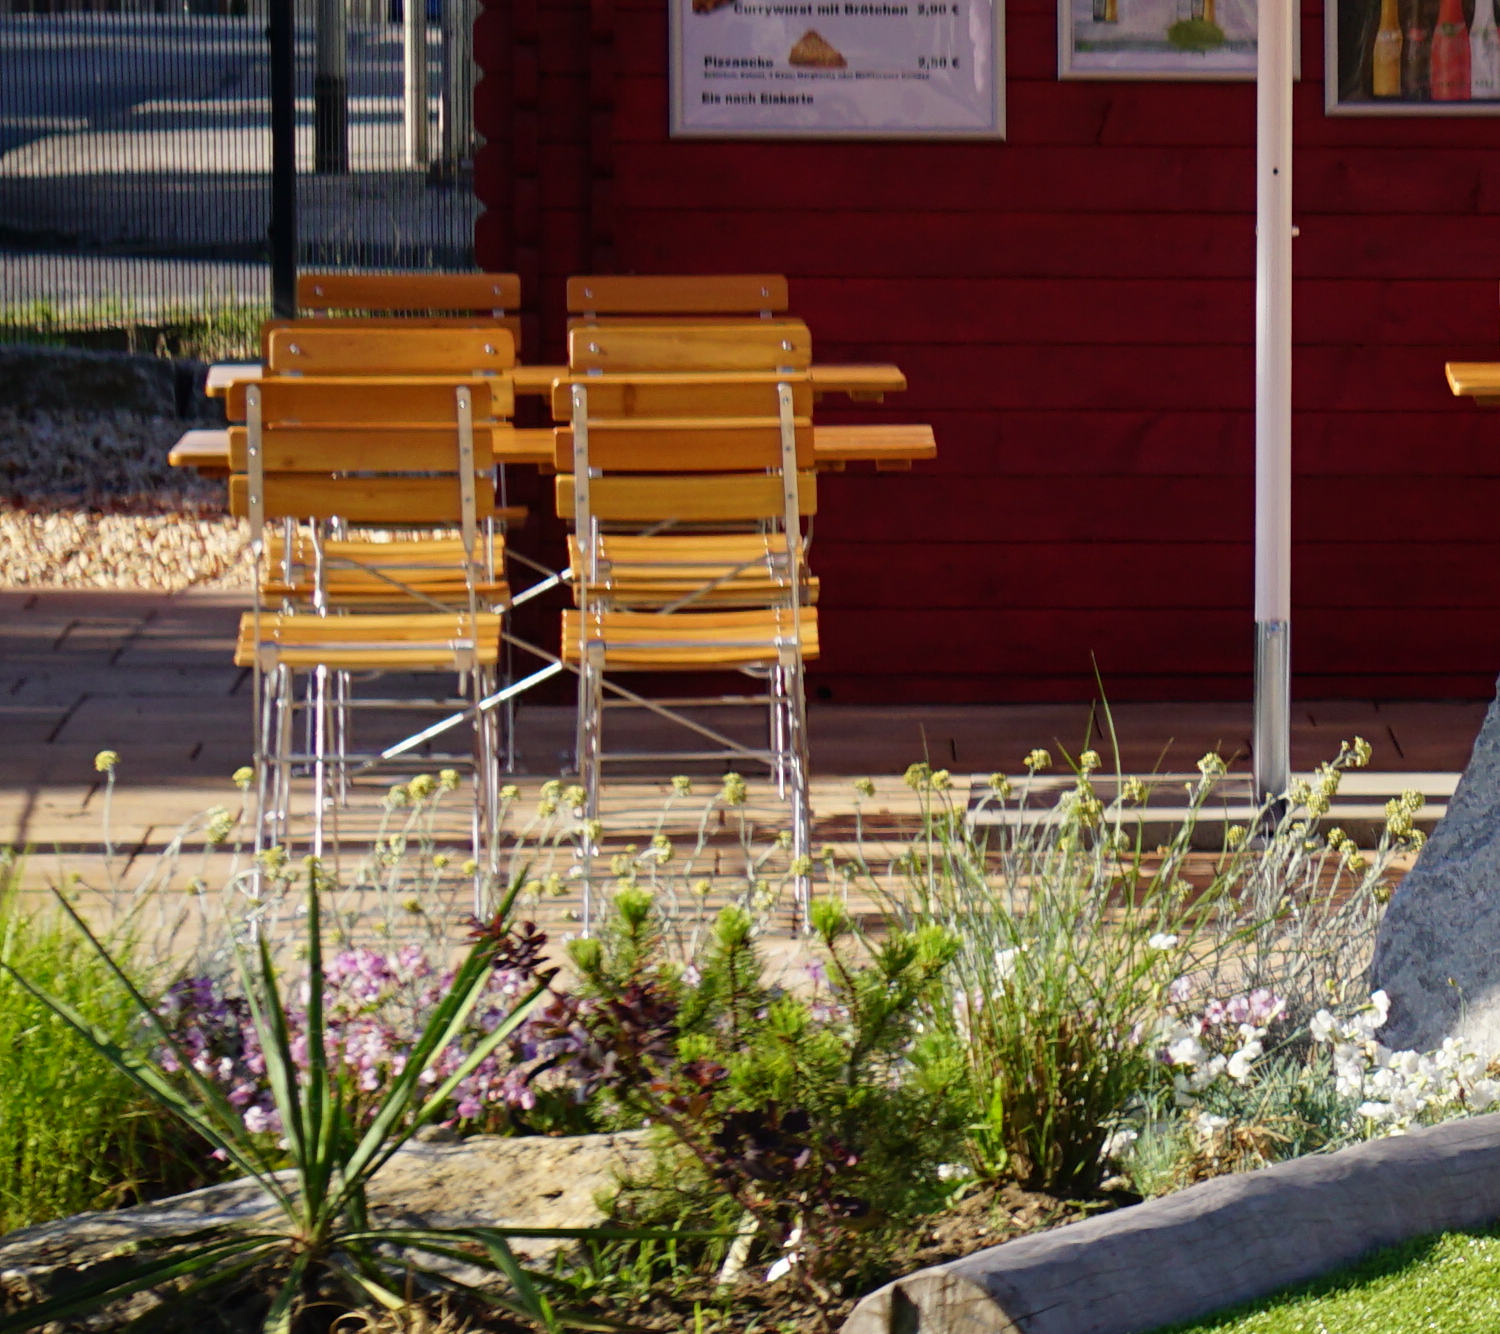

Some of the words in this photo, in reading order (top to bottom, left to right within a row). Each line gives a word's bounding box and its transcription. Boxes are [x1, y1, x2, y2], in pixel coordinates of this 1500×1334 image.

[733, 3, 812, 18] Currywurst
[817, 3, 839, 16] mit
[844, 3, 908, 16] Brötchen
[701, 91, 721, 105] Eis
[725, 91, 756, 104] nach
[760, 91, 814, 105] Eiskarte
